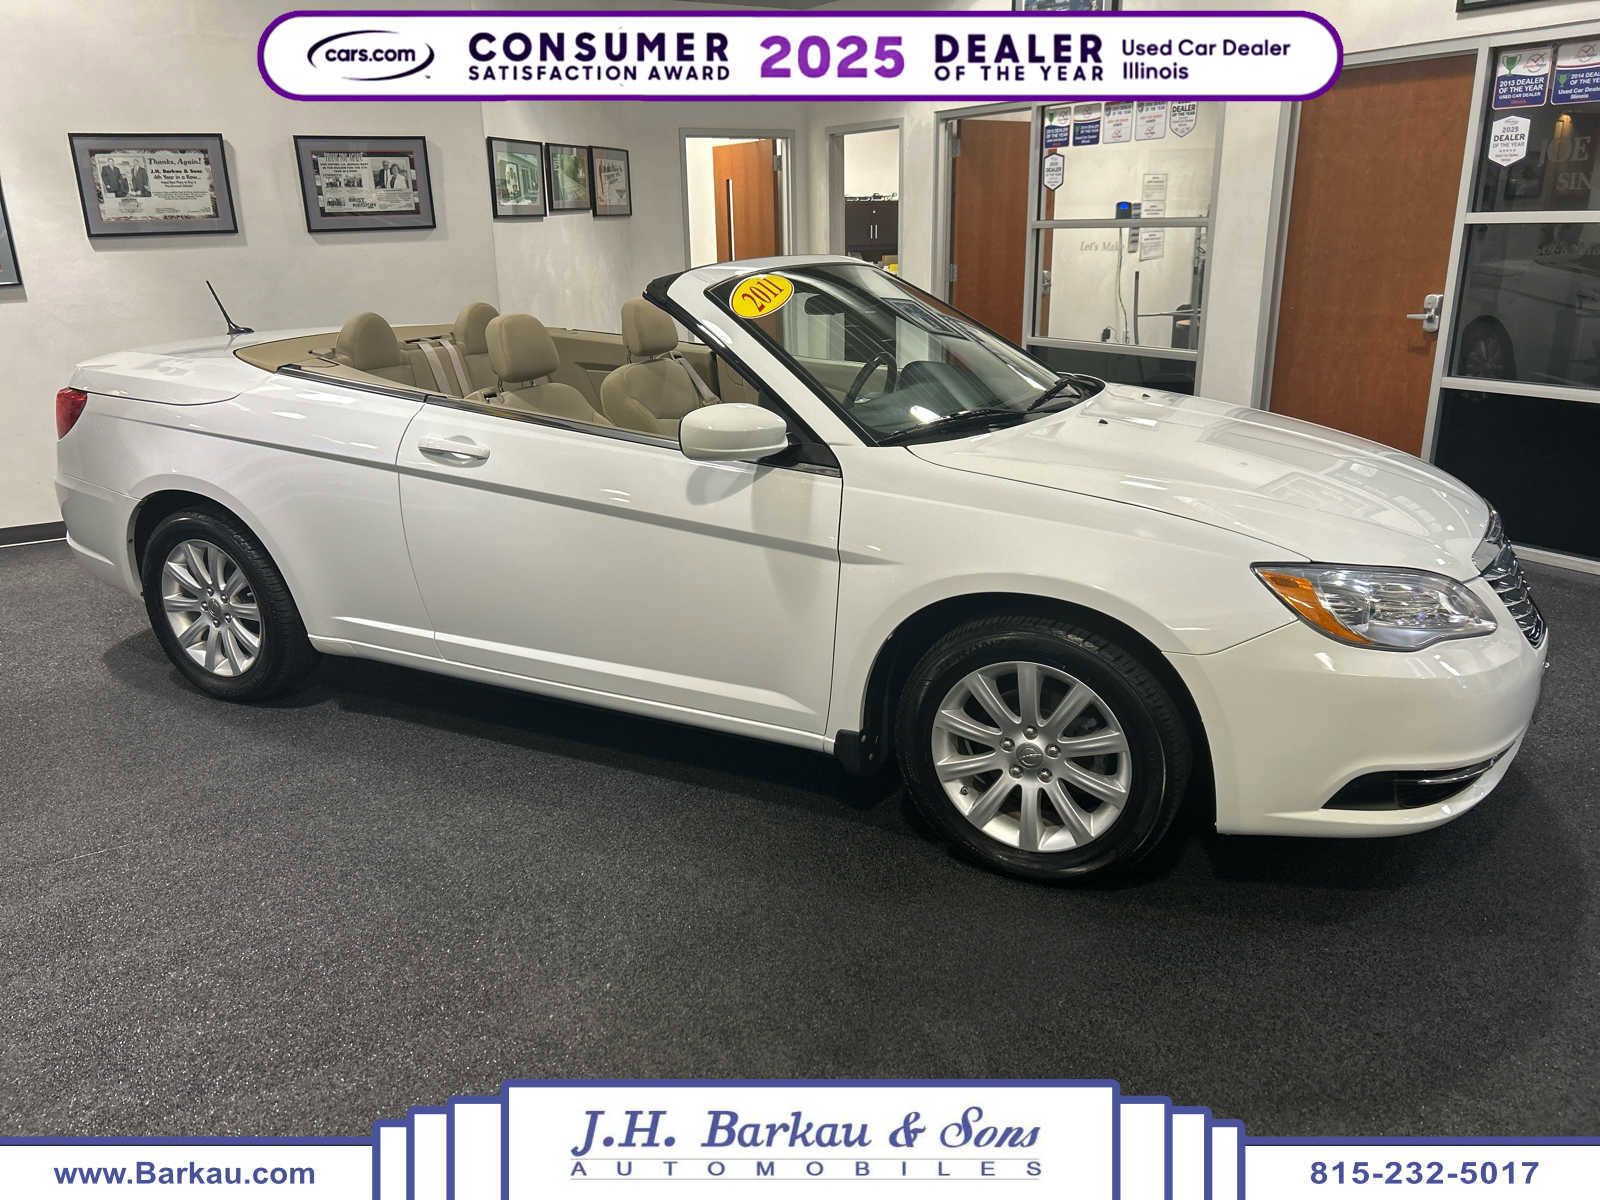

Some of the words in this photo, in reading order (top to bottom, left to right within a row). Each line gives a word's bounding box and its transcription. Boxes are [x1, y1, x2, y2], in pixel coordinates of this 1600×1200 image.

[1516, 76, 1545, 86] DEALER
[1510, 85, 1523, 93] THE
[1525, 83, 1544, 92] YEAR
[1172, 103, 1196, 112] DEALER
[1493, 133, 1526, 142] DEALER
[741, 278, 785, 312] 2011
